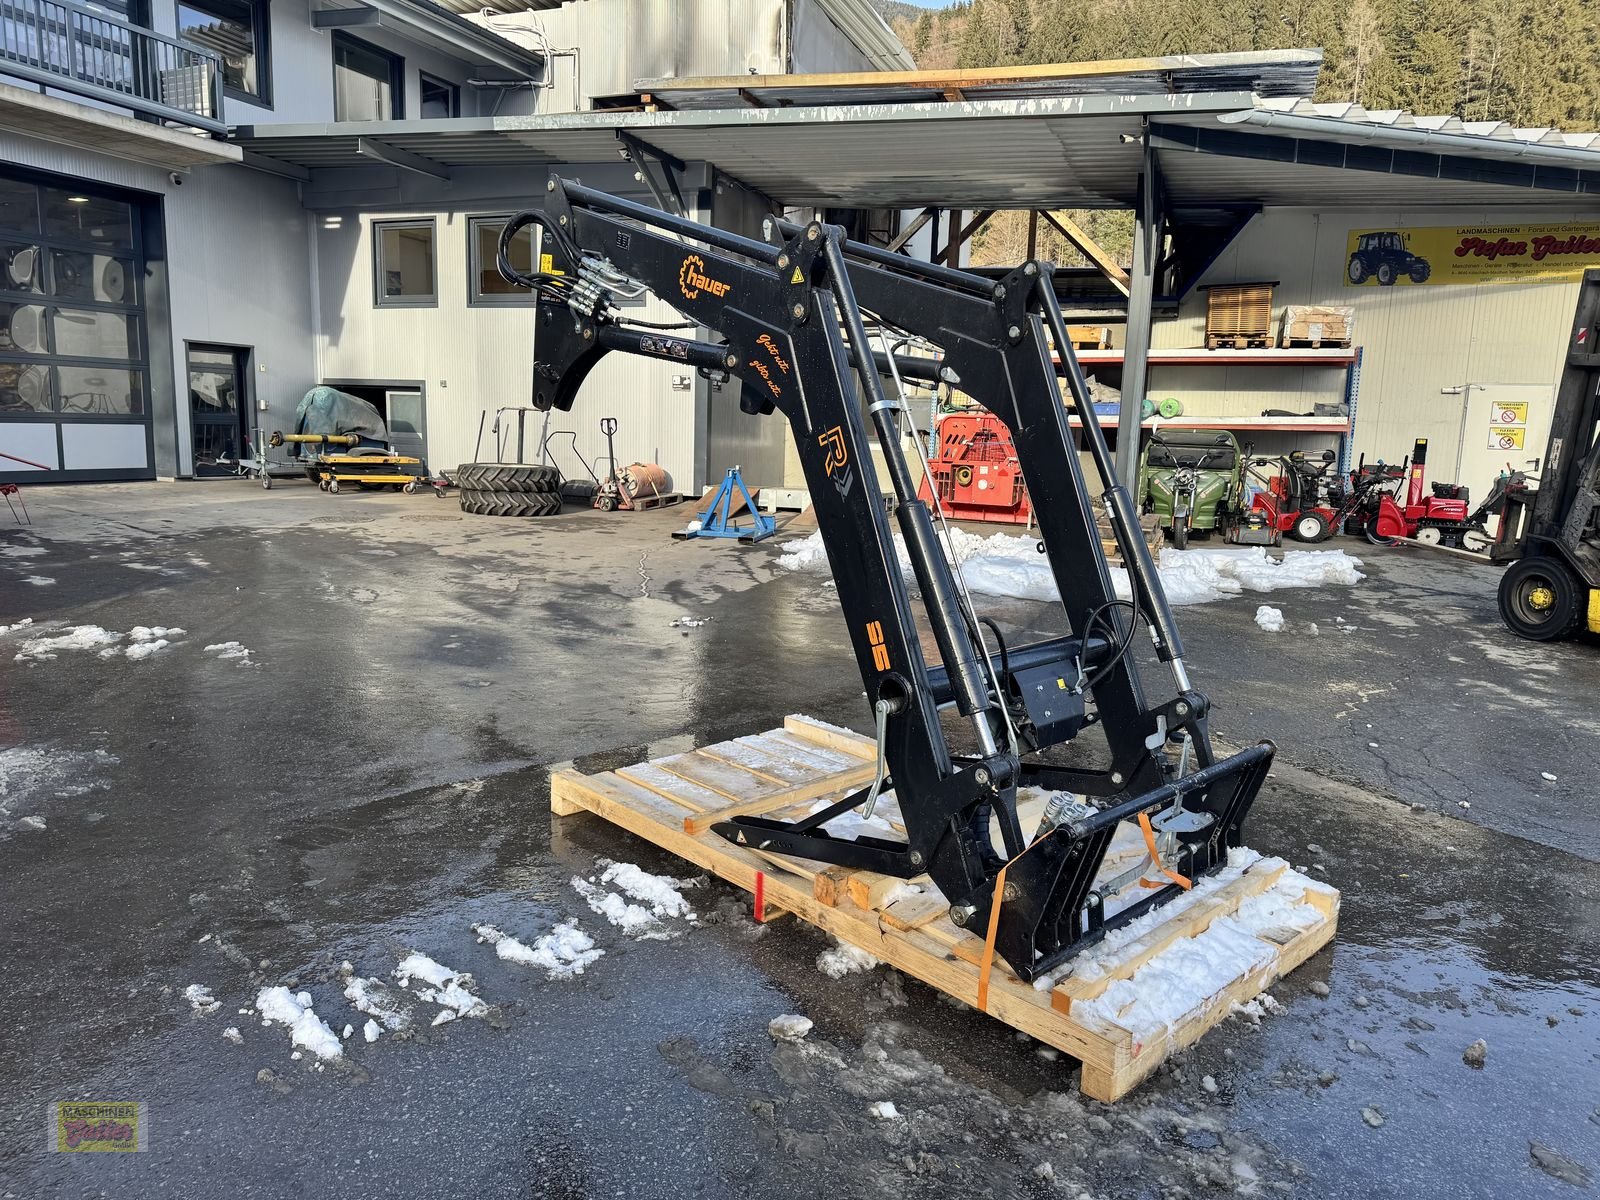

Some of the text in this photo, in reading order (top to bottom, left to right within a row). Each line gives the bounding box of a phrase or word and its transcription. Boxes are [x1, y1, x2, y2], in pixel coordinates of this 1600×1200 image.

[1456, 227, 1521, 235] LANDMASCHINEN
[1454, 236, 1528, 260] Stefan
[686, 264, 731, 297] hauer
